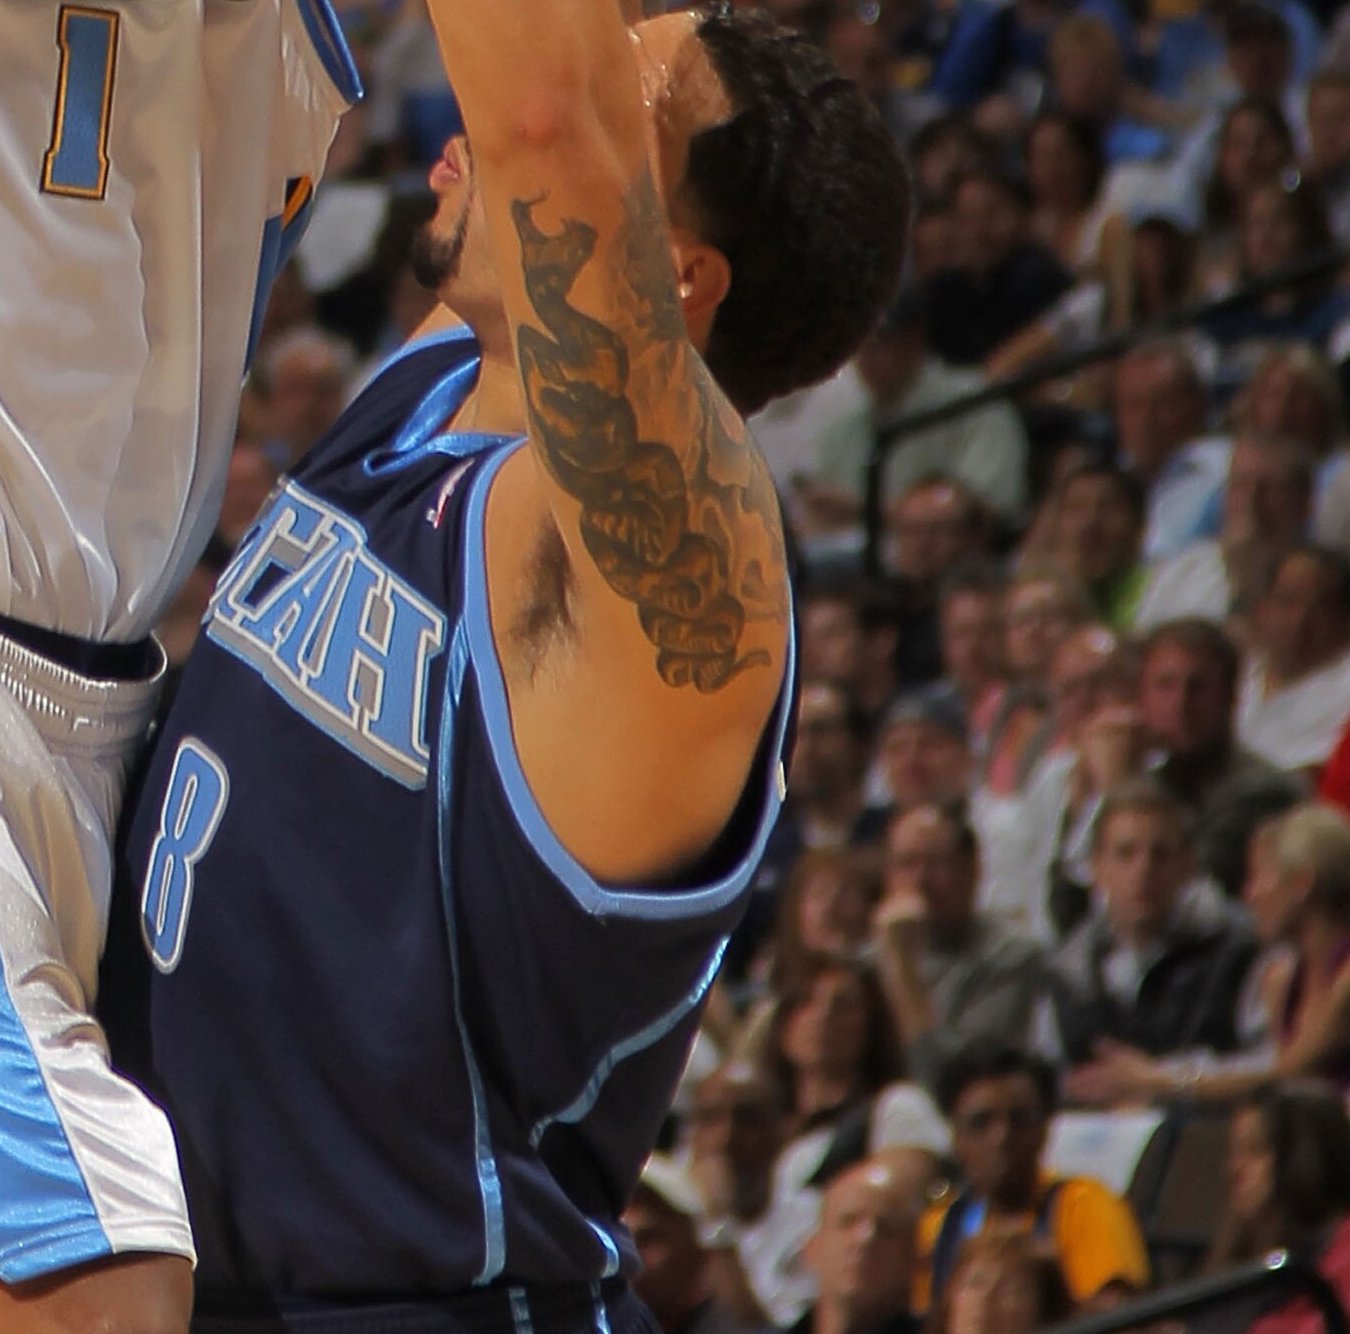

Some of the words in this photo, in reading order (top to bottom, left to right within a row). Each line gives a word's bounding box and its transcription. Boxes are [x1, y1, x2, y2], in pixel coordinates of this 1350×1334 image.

[40, 4, 119, 200] 1
[202, 479, 447, 791] TAH
[140, 736, 229, 975] 8
